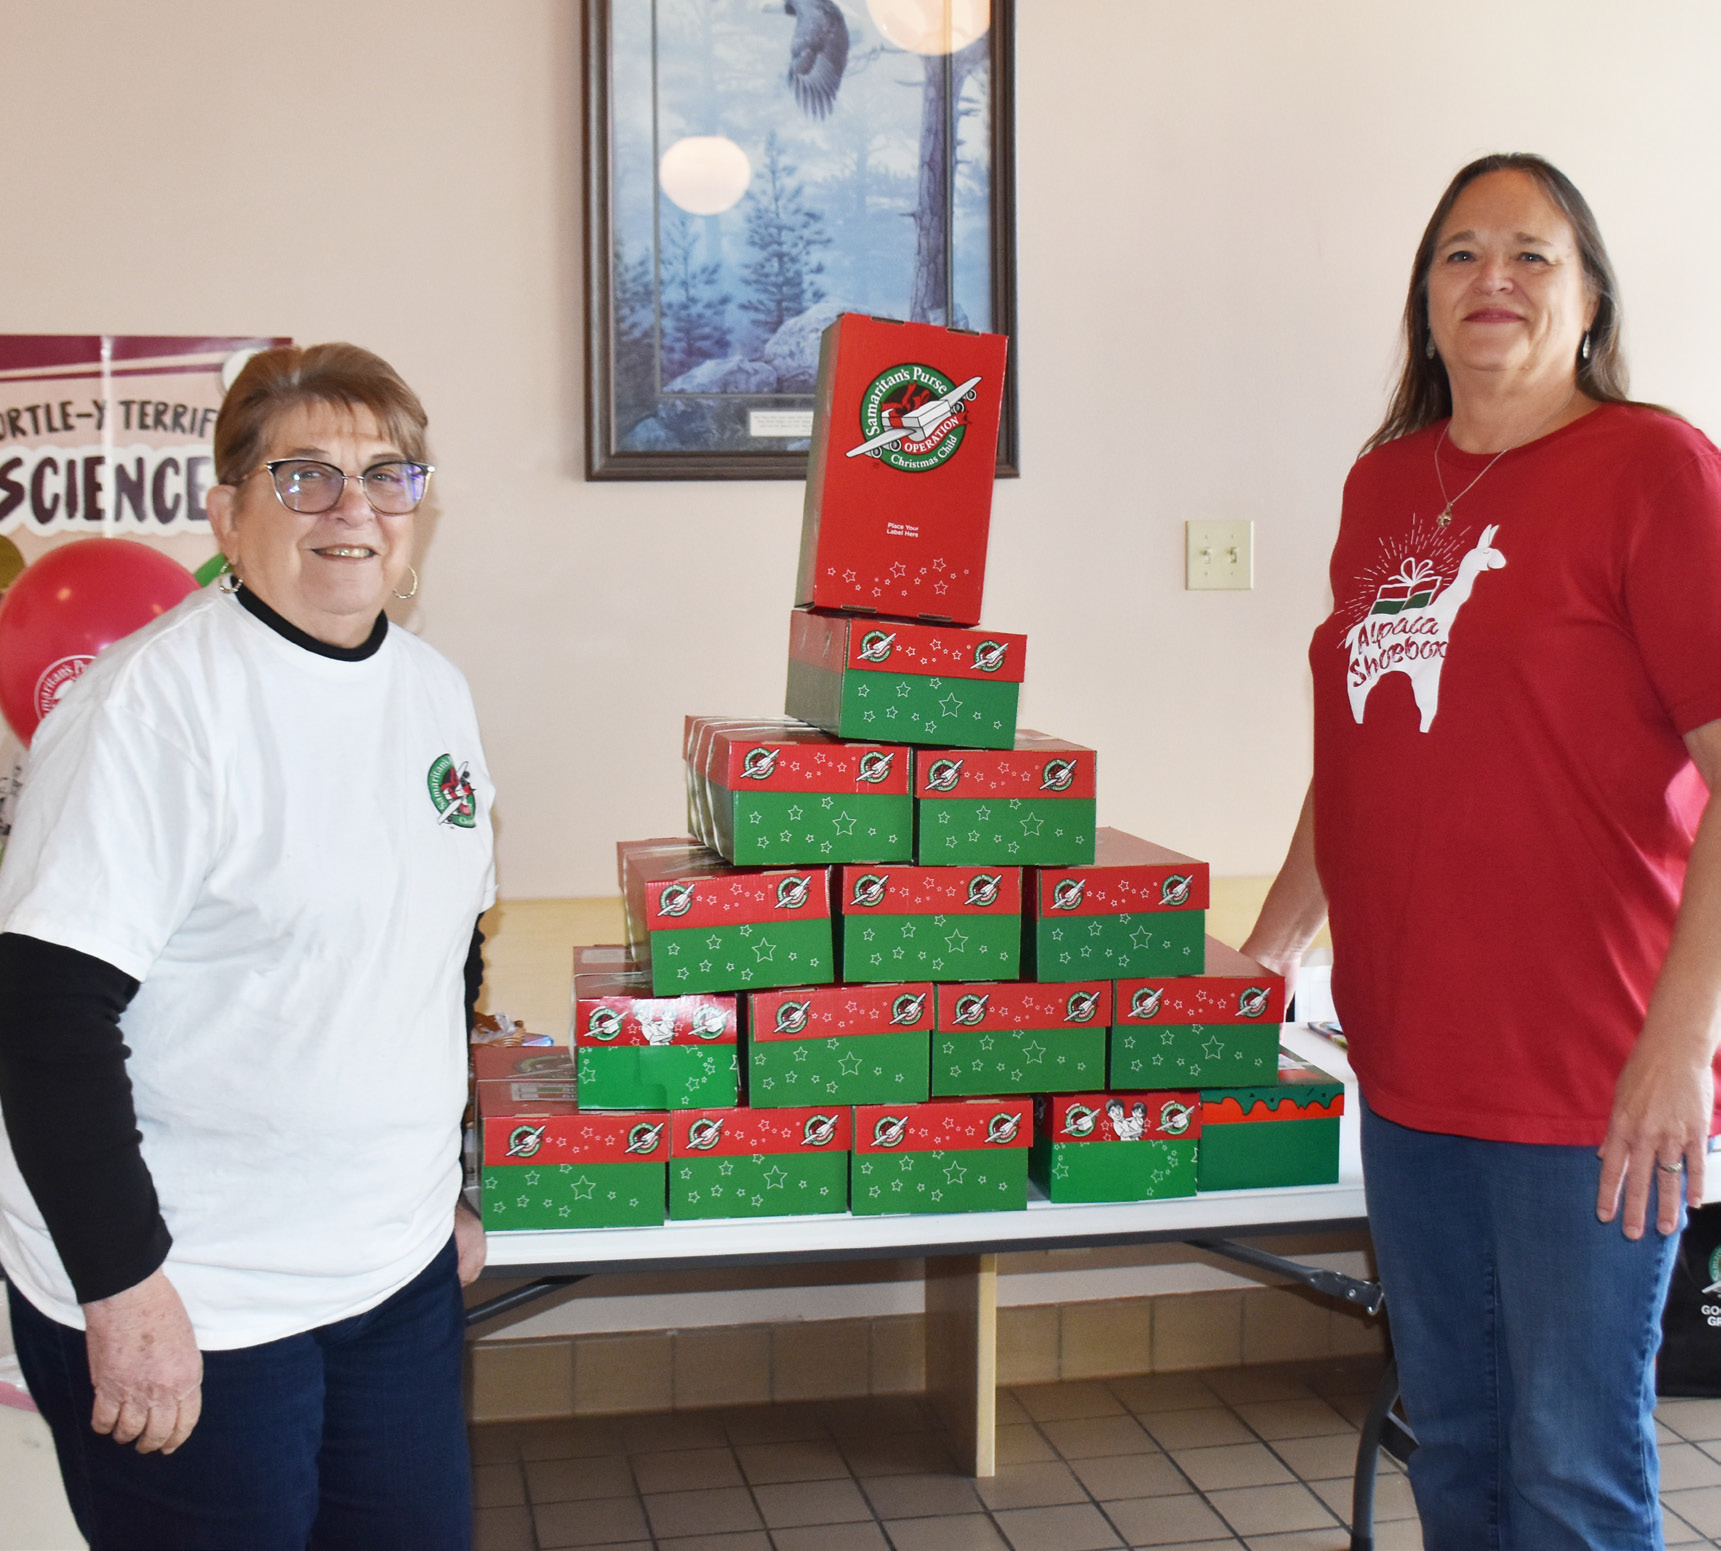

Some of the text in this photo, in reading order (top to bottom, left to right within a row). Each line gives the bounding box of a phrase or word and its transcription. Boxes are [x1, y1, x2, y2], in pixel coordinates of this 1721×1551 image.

[118, 400, 218, 438] TERRIF
[866, 366, 948, 436] Samaritan's Purse
[890, 434, 957, 469] Christmas Child
[904, 416, 959, 453] OPERATION
[0, 455, 212, 525] SCIENCE
[887, 522, 904, 530] Place
[904, 530, 919, 538] Here
[1358, 616, 1439, 655] Alpaca
[1350, 636, 1449, 687] Shoebox
[1701, 1305, 1721, 1315] GO
